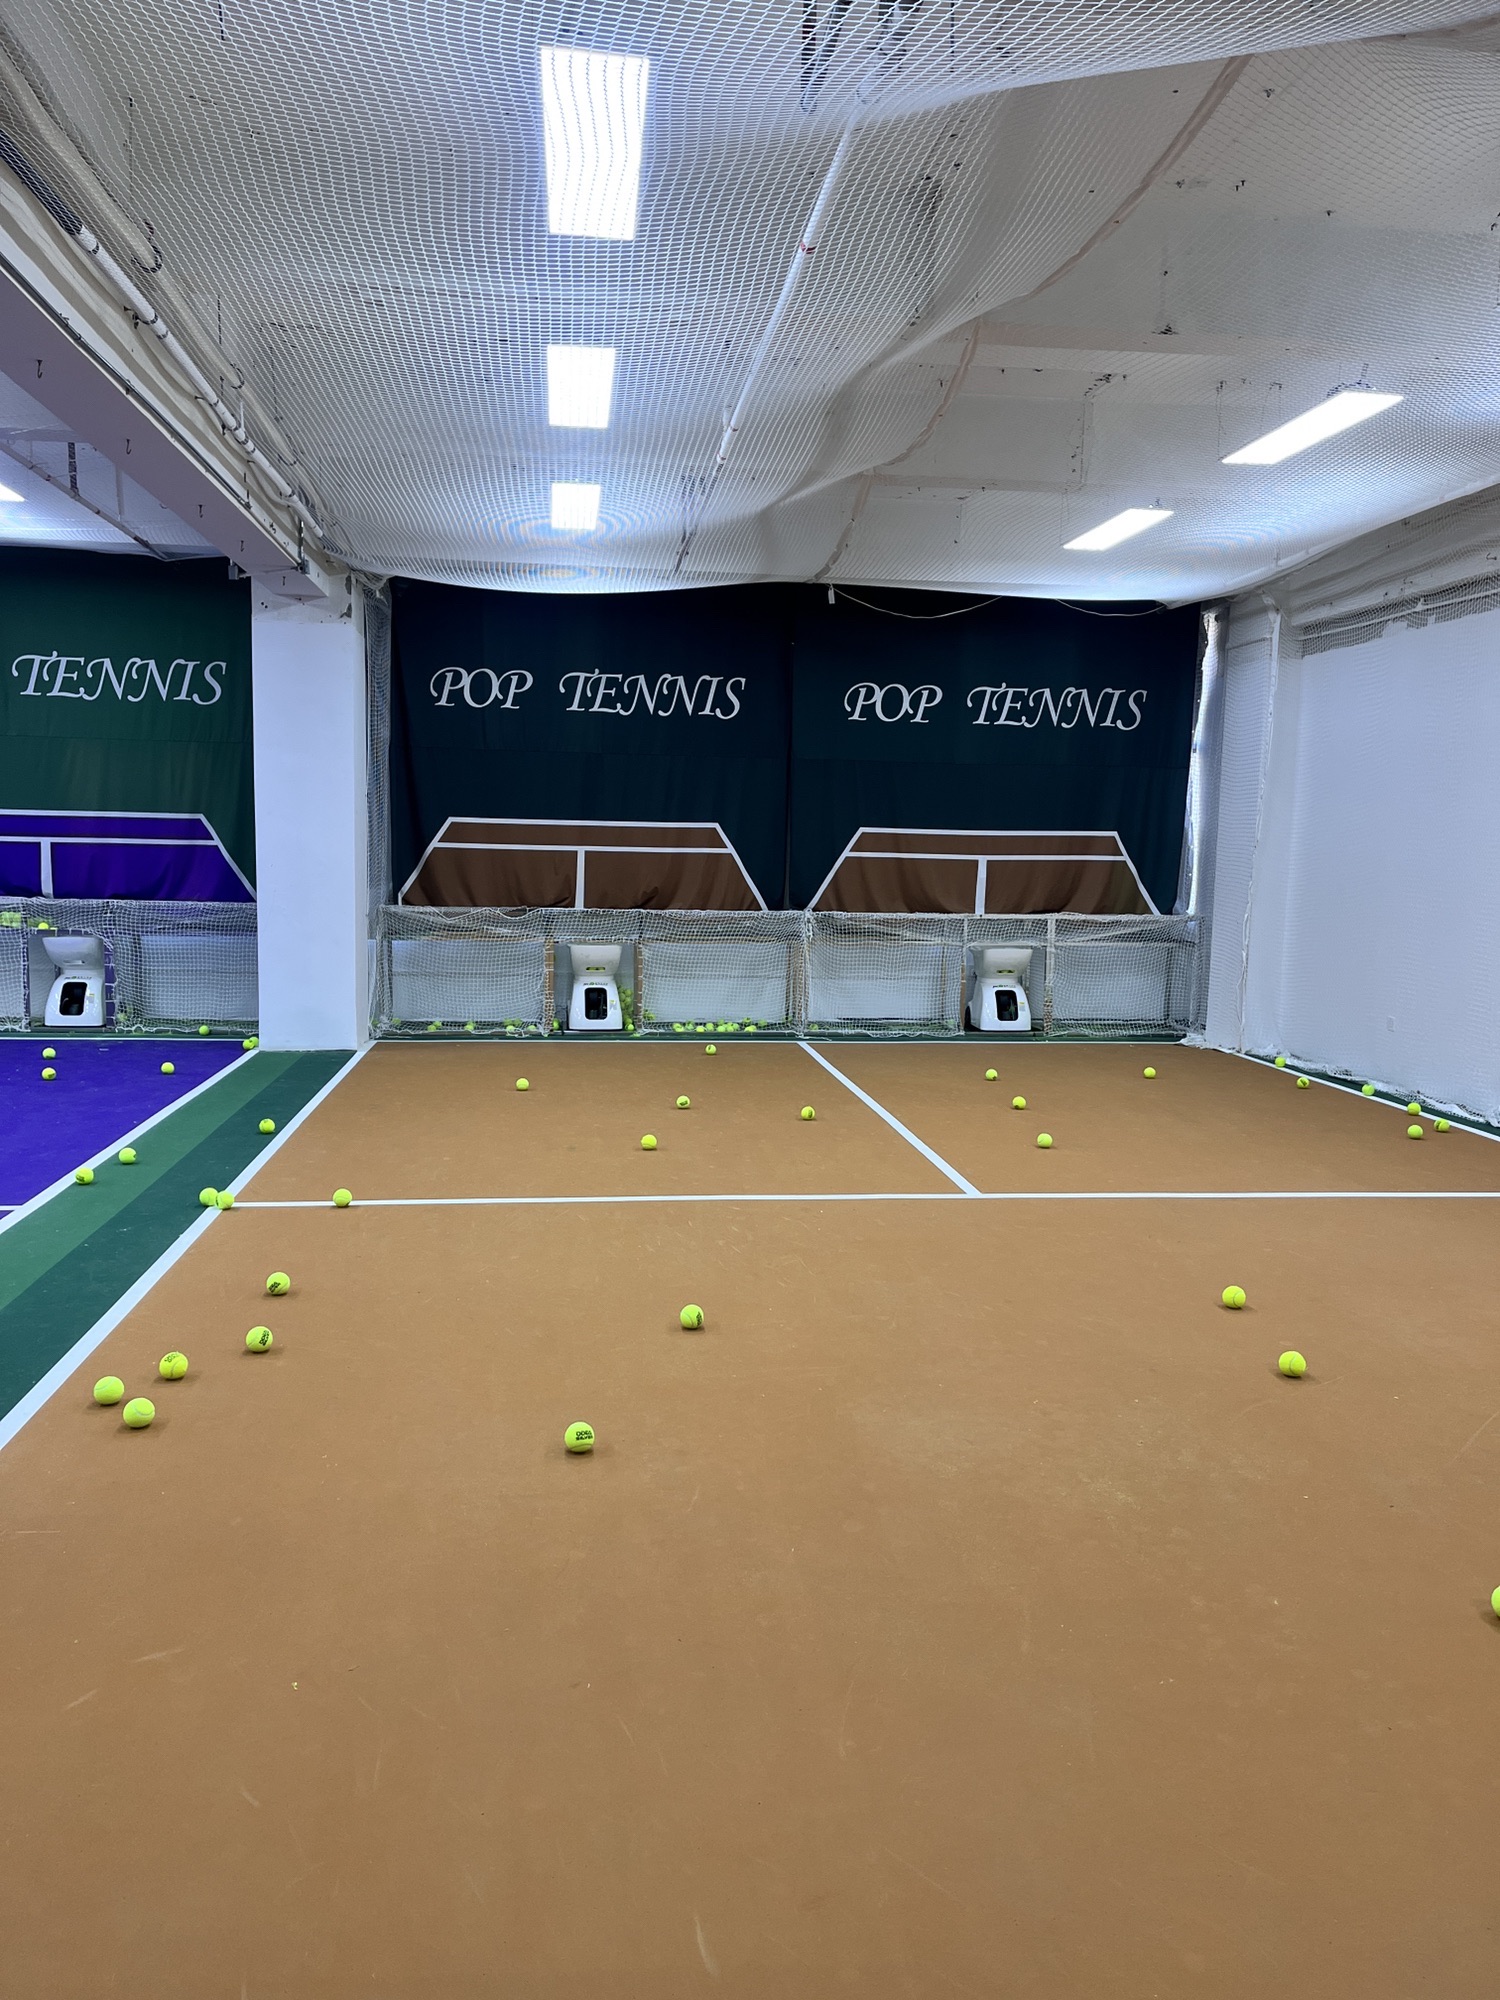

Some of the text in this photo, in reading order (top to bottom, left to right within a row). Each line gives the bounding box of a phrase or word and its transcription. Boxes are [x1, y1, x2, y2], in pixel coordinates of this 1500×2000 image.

[12, 651, 227, 706] TENNIS
[430, 667, 746, 720] POP TENNIS
[843, 682, 1148, 732] POP TENNIS
